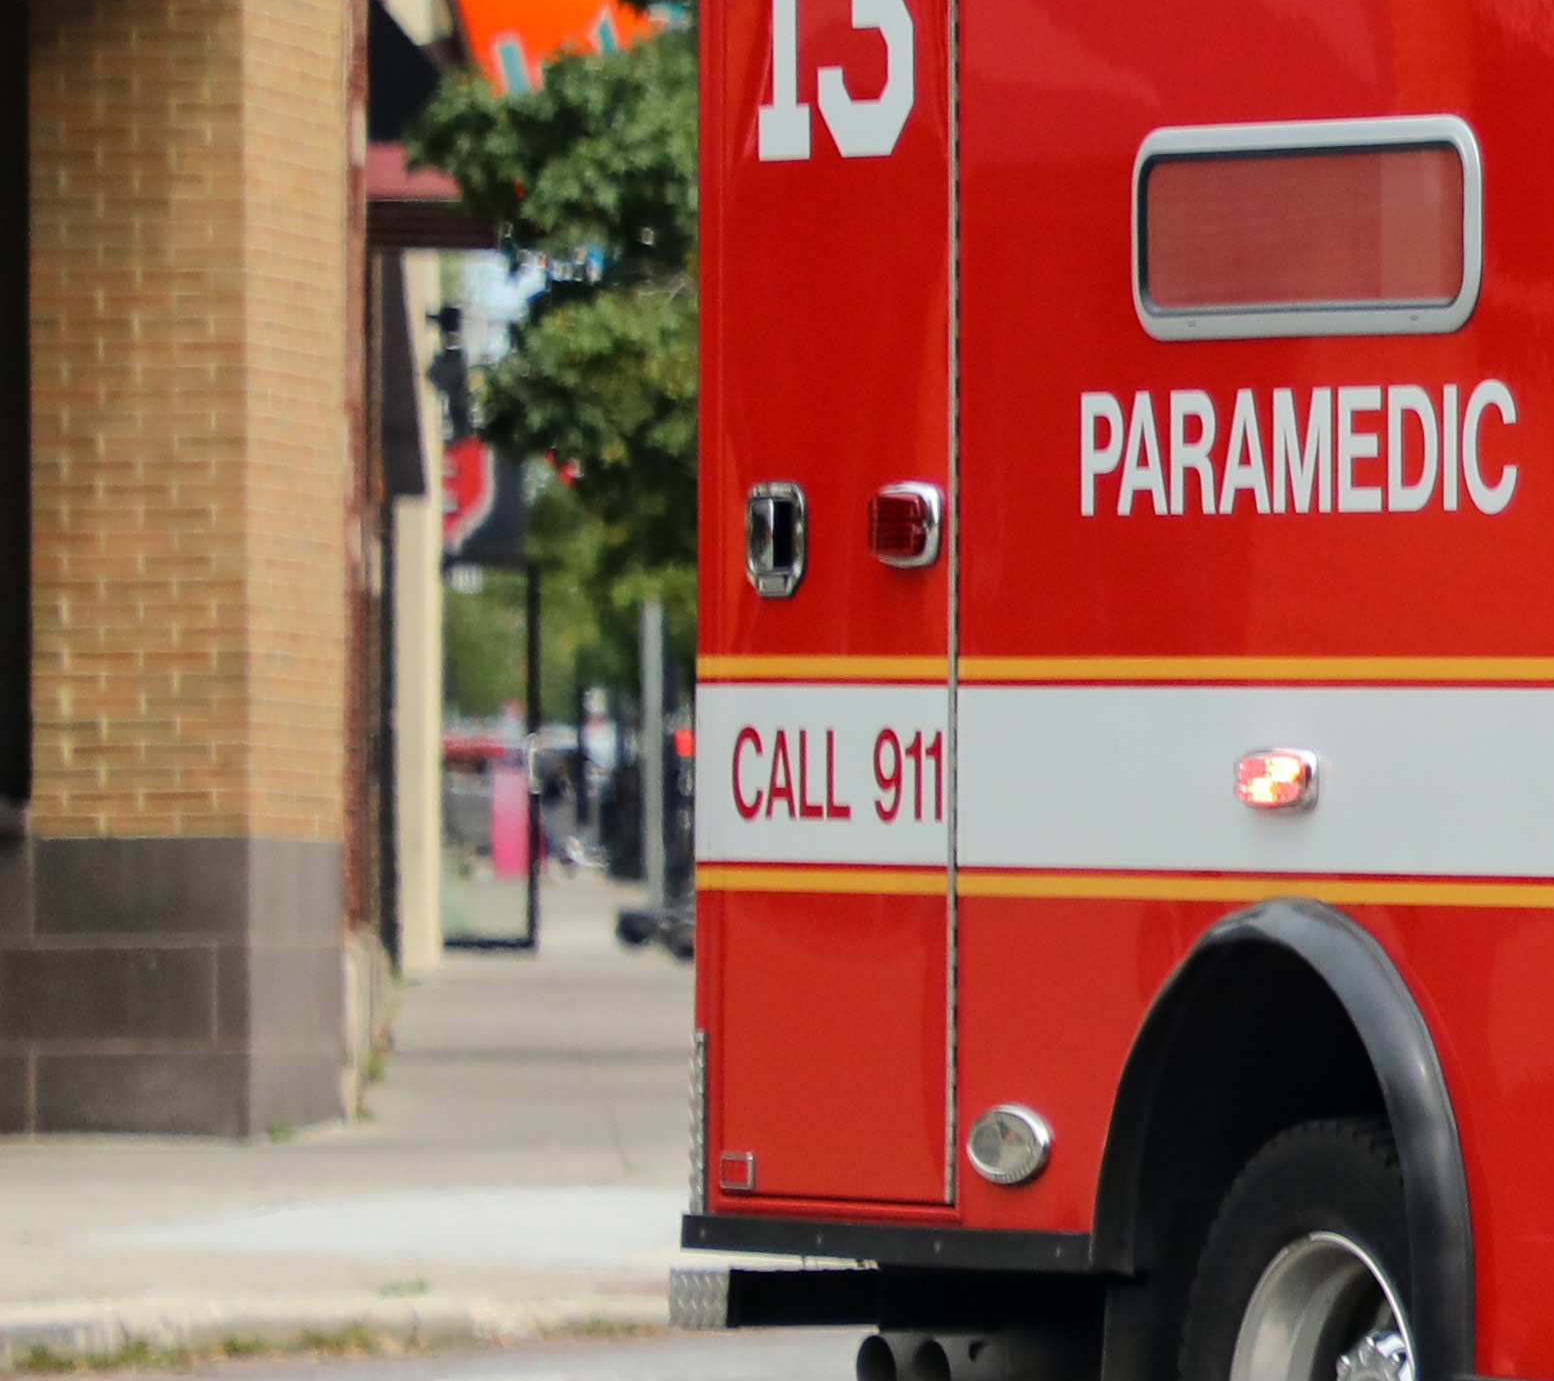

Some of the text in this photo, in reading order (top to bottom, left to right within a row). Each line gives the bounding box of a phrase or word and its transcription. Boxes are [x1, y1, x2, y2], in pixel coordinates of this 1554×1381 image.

[1081, 379, 1517, 515] PARAMEDIC
[732, 726, 943, 822] CALL 911
